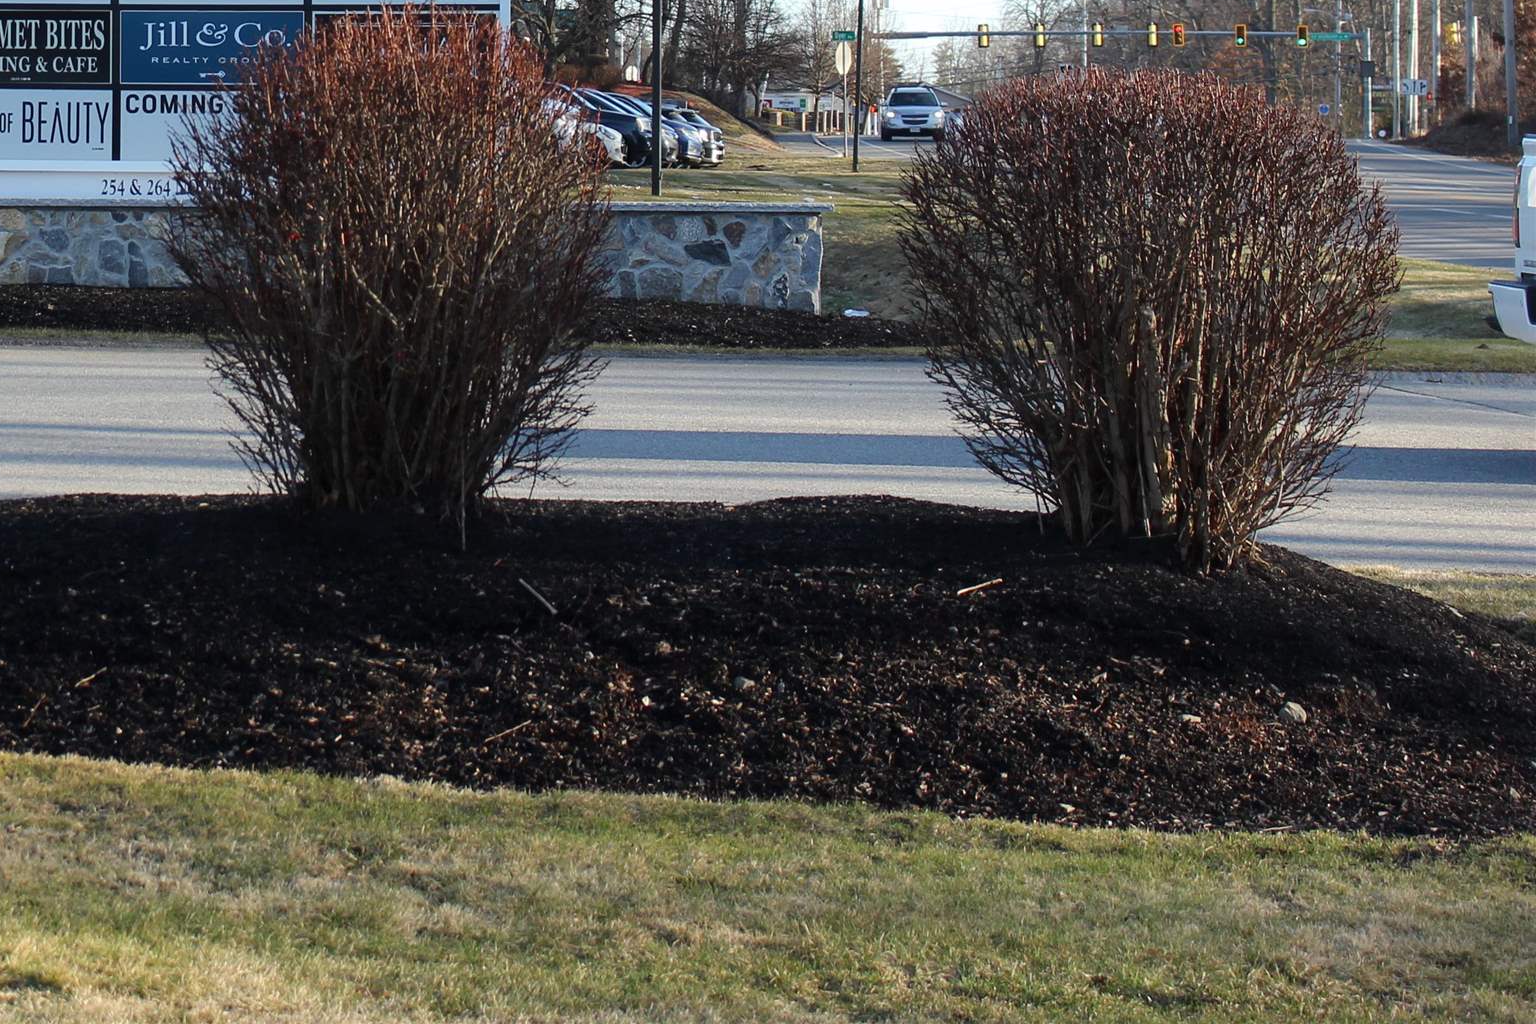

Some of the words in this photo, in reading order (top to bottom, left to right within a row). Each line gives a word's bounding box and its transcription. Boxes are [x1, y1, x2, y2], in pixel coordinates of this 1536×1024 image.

[45, 19, 105, 51] BITES
[139, 20, 191, 51] Jill
[195, 22, 229, 47] &
[233, 22, 292, 48] Co.
[35, 56, 48, 73] &
[52, 56, 98, 73] CAFE
[151, 56, 209, 64] REALTY
[125, 94, 224, 114] COMING
[0, 112, 13, 133] OF
[101, 179, 125, 196] 254
[129, 179, 142, 196] &
[147, 179, 170, 196] 264
